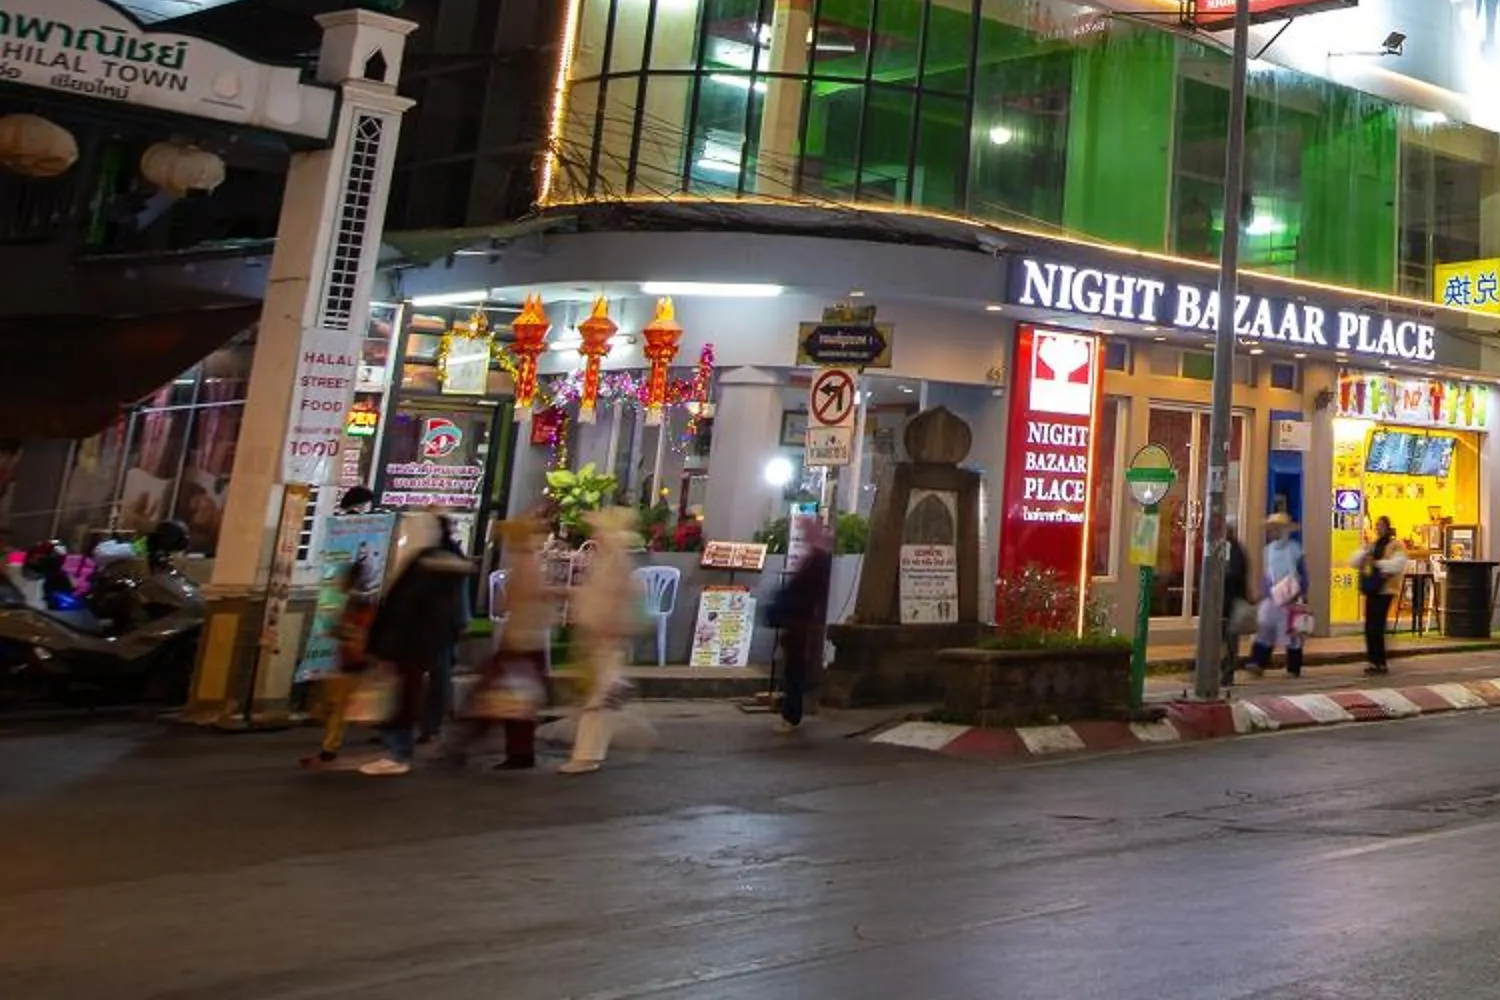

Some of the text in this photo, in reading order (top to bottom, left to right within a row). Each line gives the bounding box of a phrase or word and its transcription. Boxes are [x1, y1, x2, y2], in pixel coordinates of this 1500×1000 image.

[2, 42, 189, 92] HILAL TOWN
[1019, 259, 1436, 361] NIGHT BAZAAR PLACE
[303, 351, 355, 366] HALAL
[301, 375, 351, 389] STREET
[301, 399, 343, 413] FOOD
[1027, 420, 1089, 447] NIGHT
[1024, 451, 1088, 473] BAZAAR
[1023, 476, 1086, 502] PLACE
